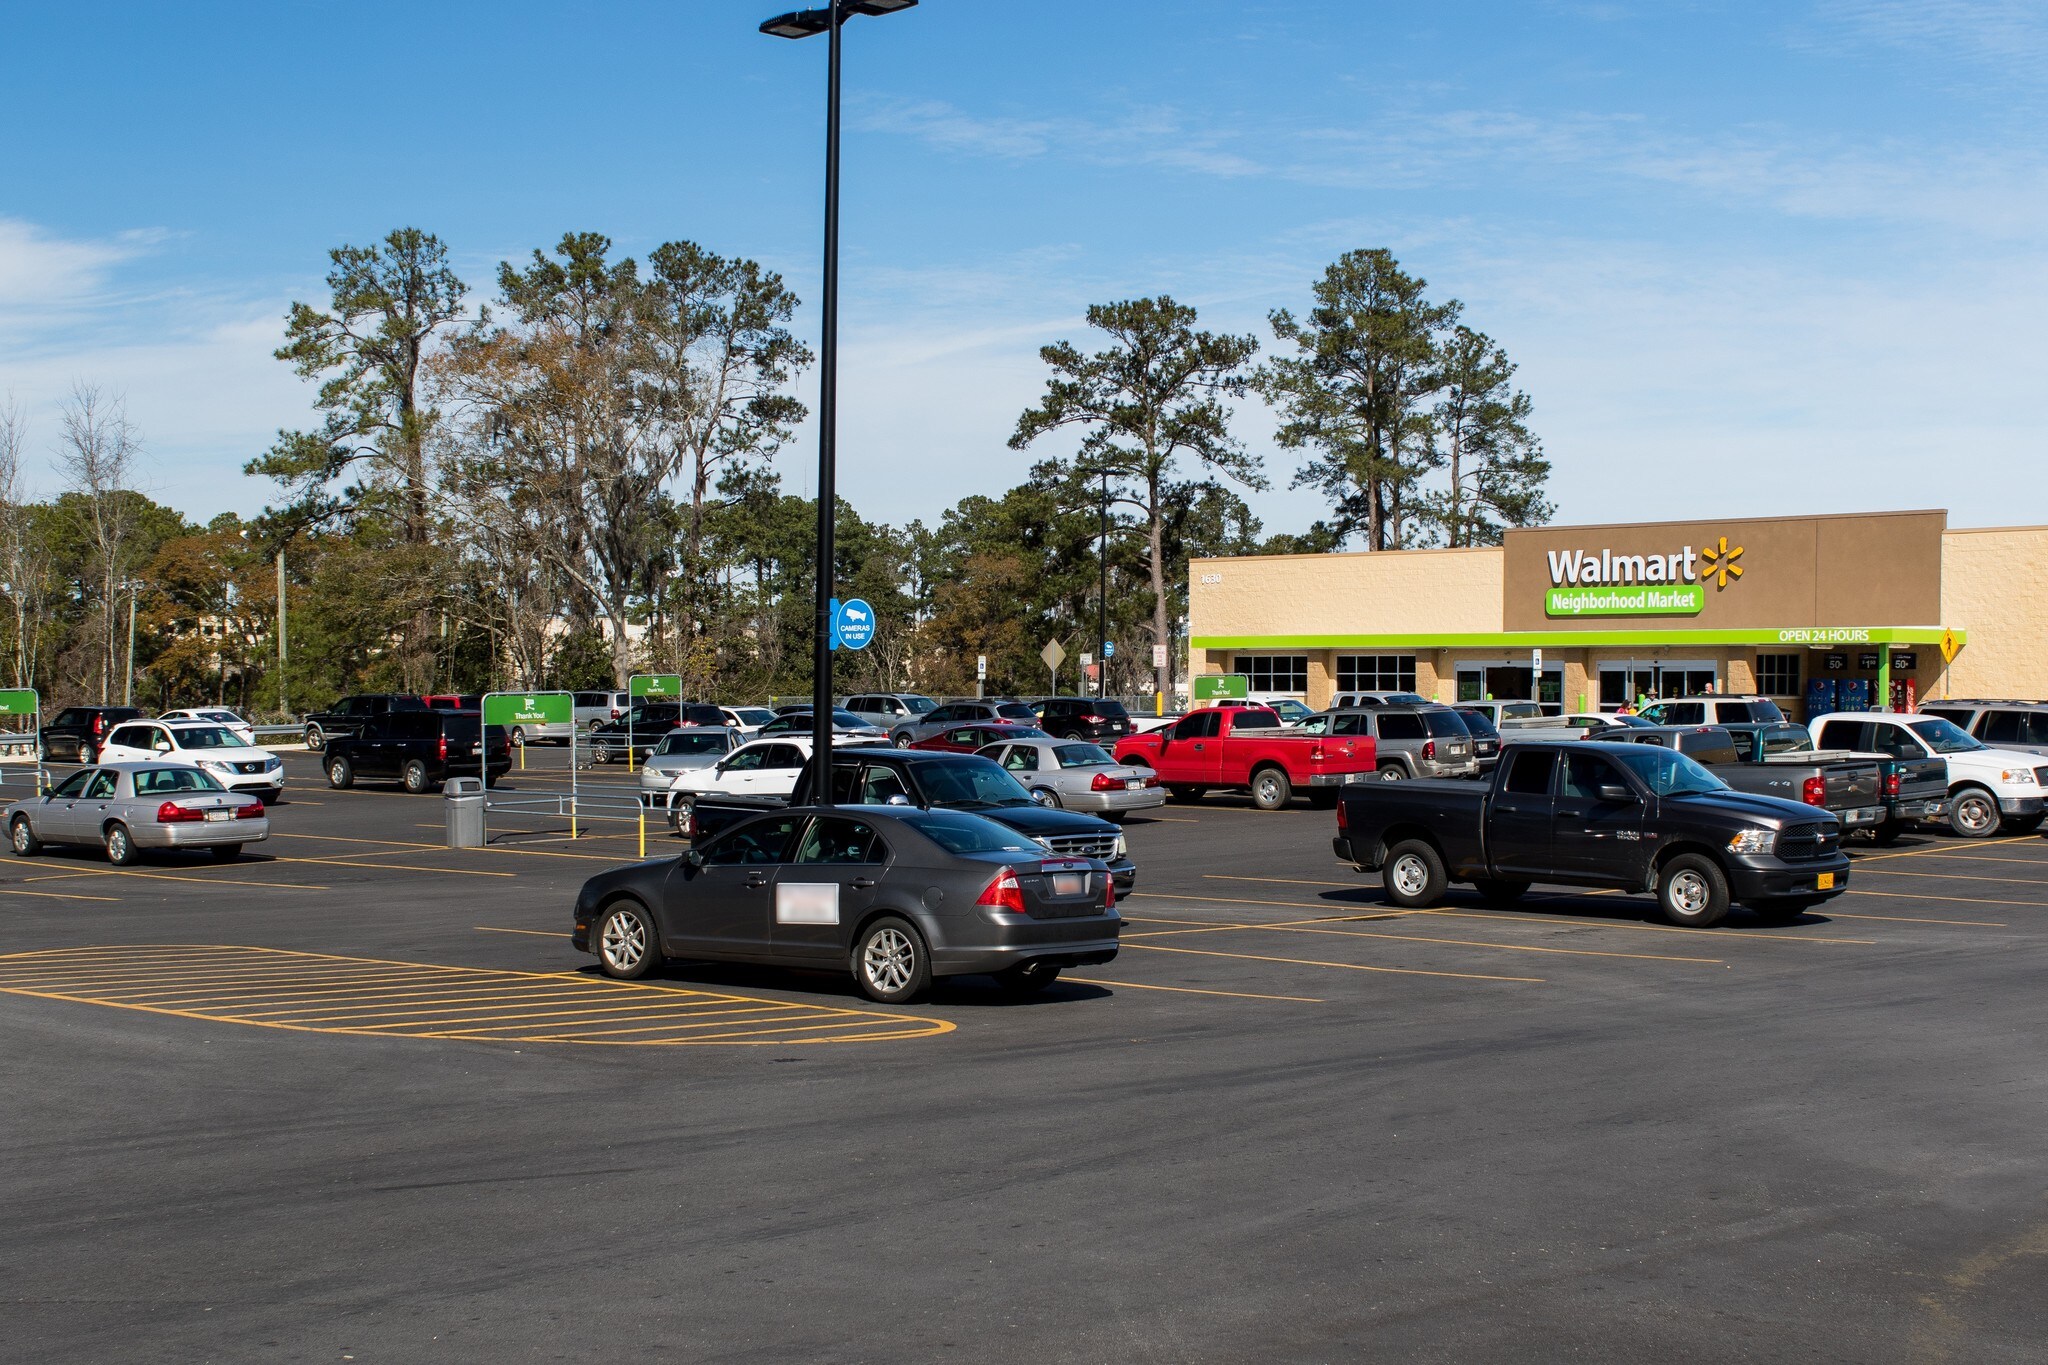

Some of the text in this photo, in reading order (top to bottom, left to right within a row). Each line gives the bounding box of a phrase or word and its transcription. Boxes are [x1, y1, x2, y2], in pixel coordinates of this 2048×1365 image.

[1548, 546, 1696, 583] Walmart
[1201, 574, 1221, 584] 1630
[1552, 591, 1694, 613] Neighborhood Market
[1779, 629, 1869, 641] OPEN 24 HOURS
